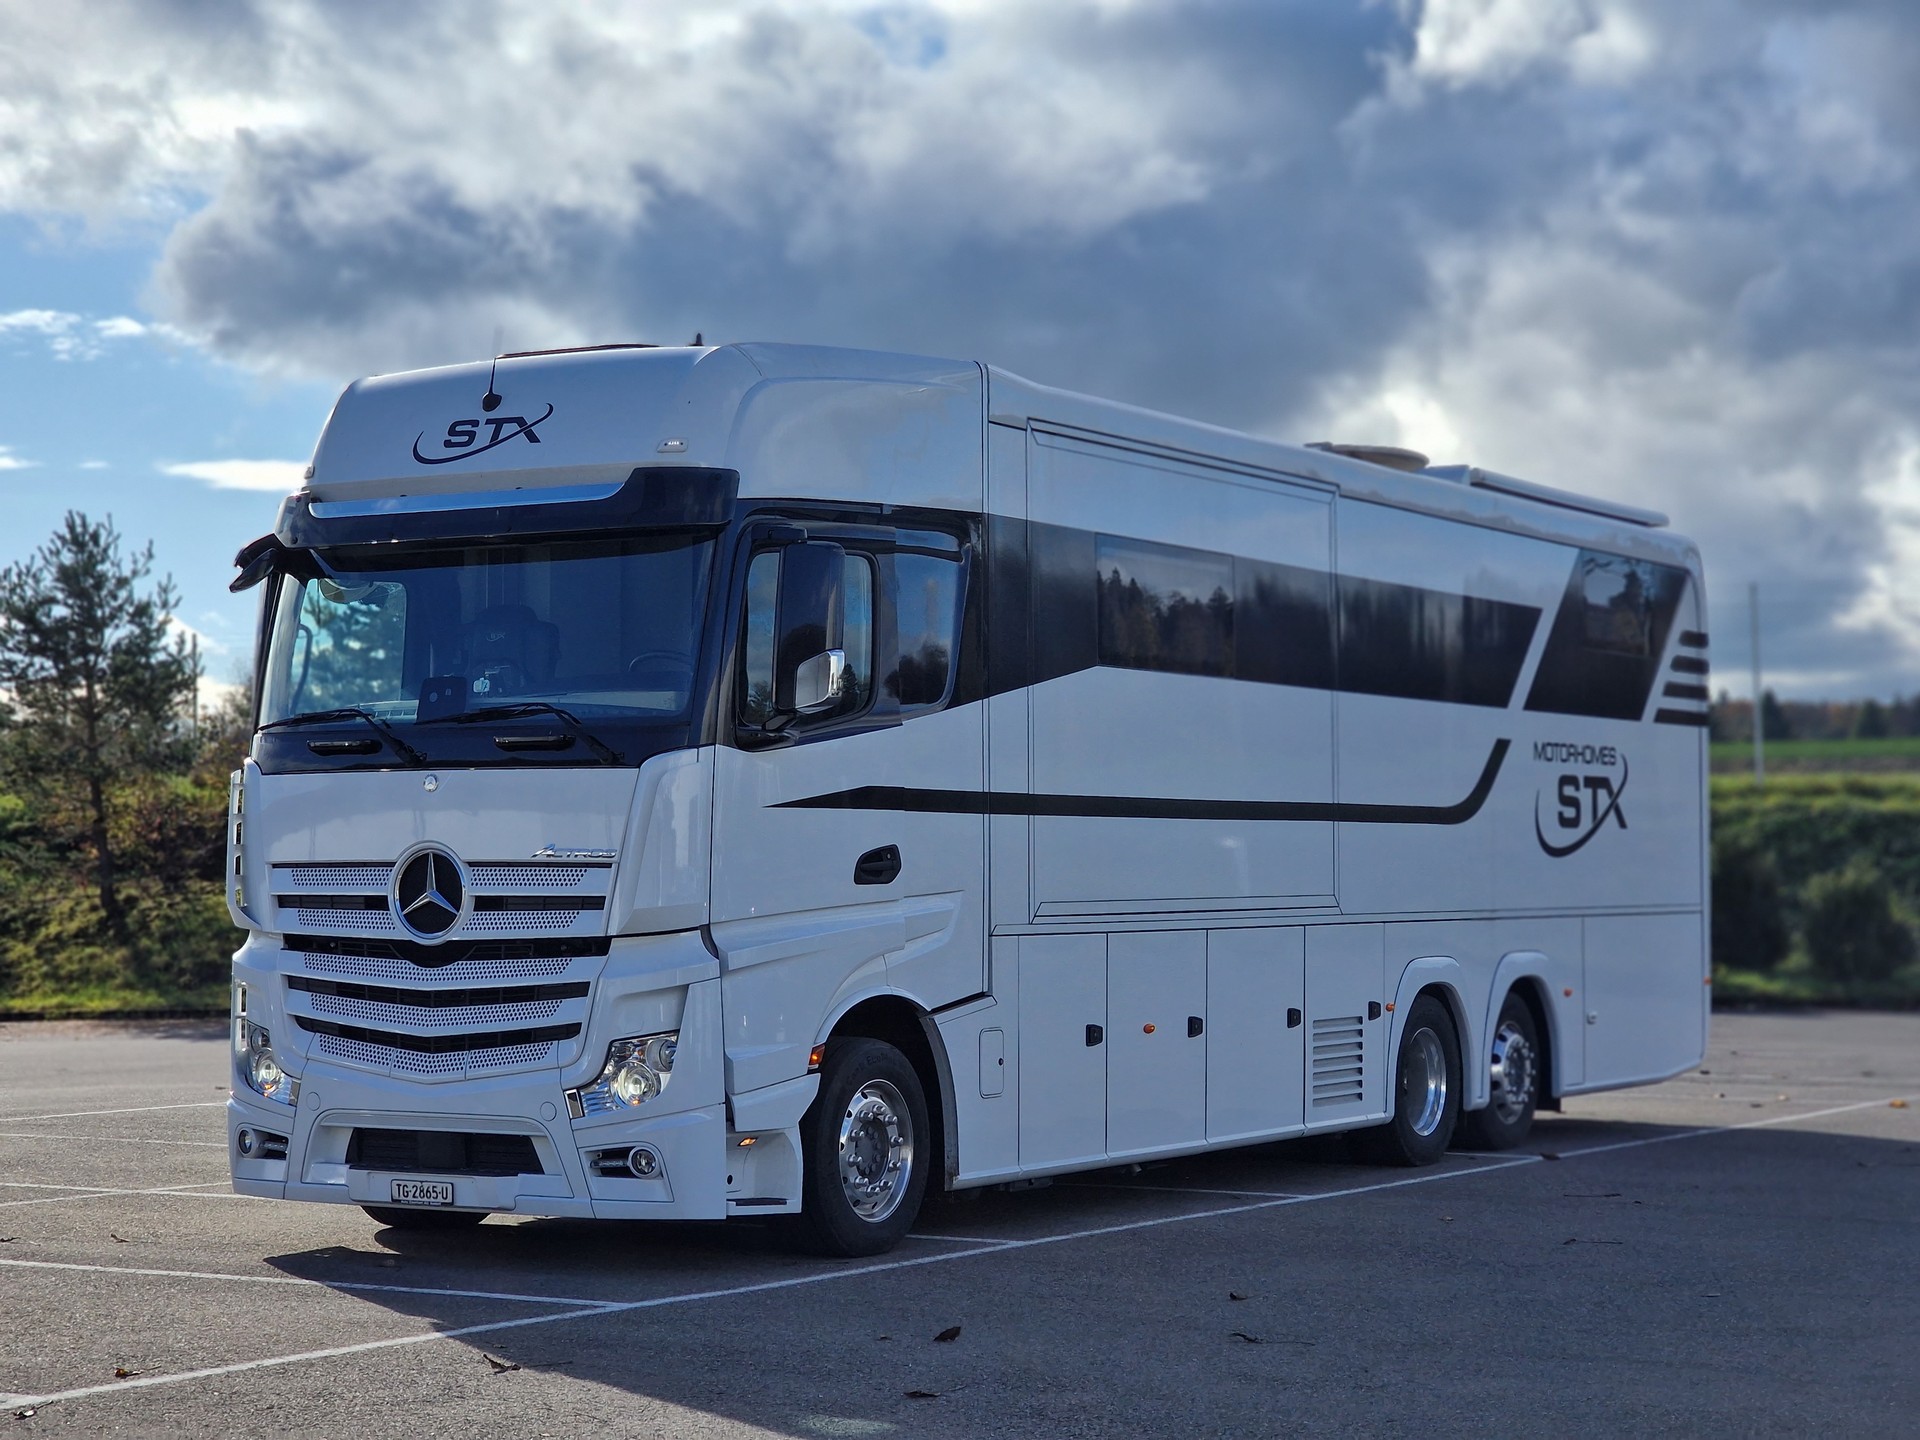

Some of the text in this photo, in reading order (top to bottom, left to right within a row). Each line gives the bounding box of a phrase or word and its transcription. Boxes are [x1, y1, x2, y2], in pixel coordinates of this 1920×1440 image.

[443, 416, 541, 449] STX
[1533, 741, 1617, 766] MOTORHOMES
[1558, 774, 1628, 829] STX
[530, 843, 617, 858] ACTROS
